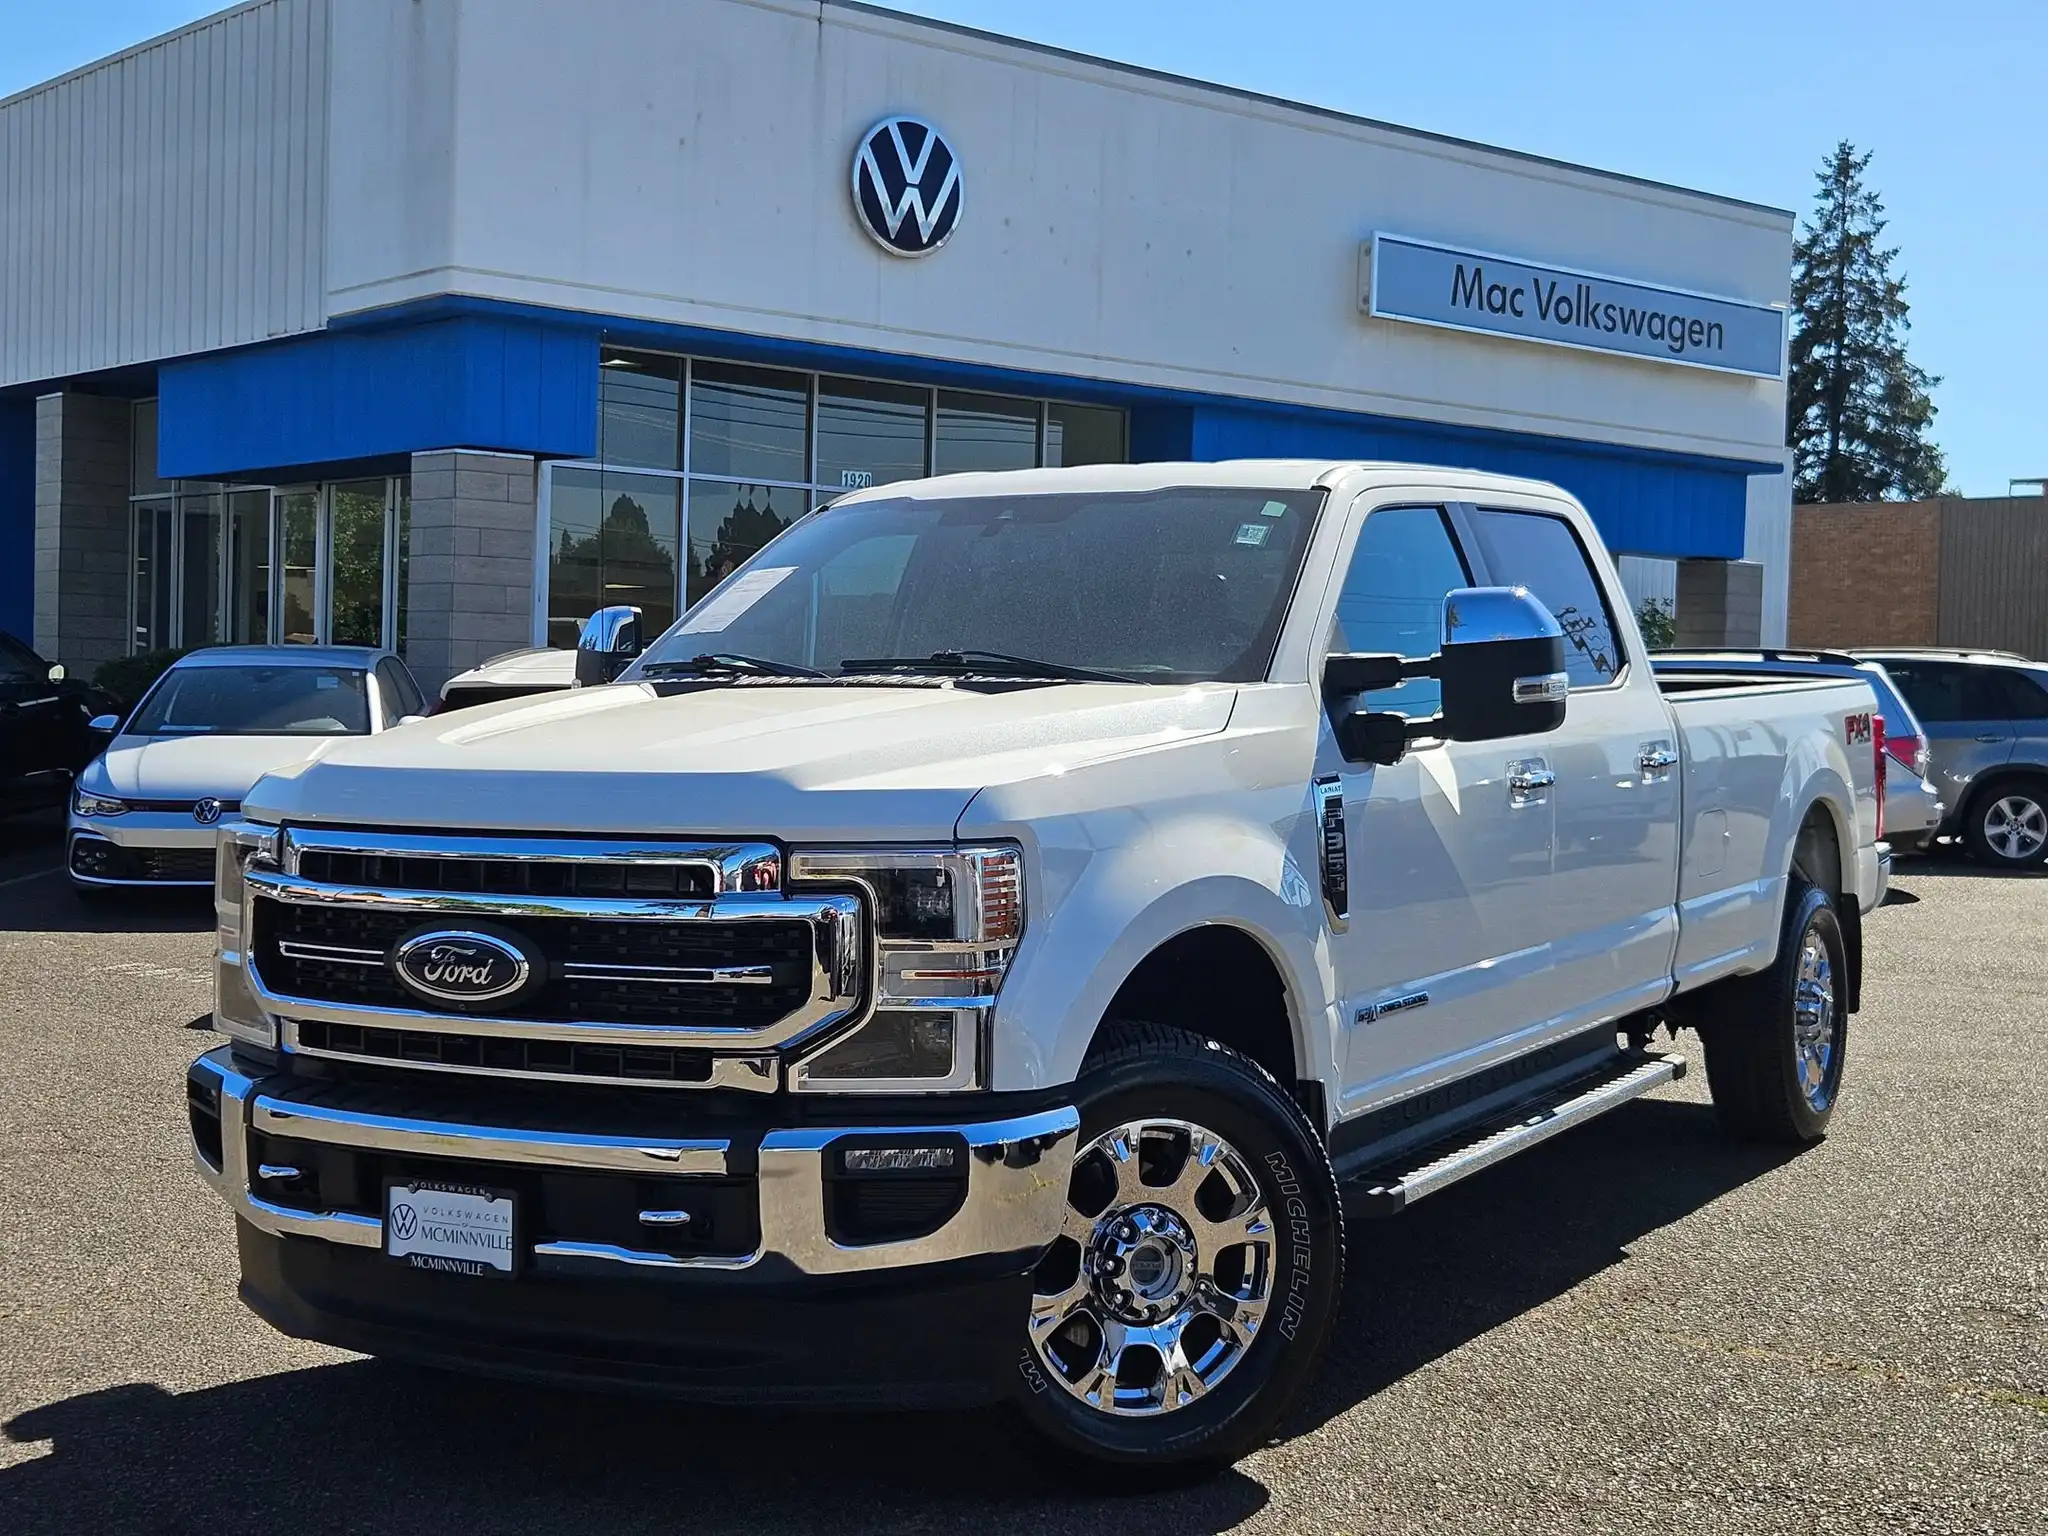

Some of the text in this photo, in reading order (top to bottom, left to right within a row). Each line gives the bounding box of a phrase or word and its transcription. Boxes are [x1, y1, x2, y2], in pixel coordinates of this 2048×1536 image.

[1450, 264, 1724, 354] Mac Volkswagen
[844, 472, 871, 488] 1920
[1844, 712, 1871, 745] FX4
[424, 945, 494, 985] Ford
[413, 1180, 486, 1195] VOLKSWAGEN
[423, 1206, 509, 1223] VOLKSWAGEN
[421, 1226, 513, 1251] MCMINNVILLE
[1264, 1151, 1312, 1341] MICHELIN
[410, 1255, 484, 1276] MCMINNVILLE
